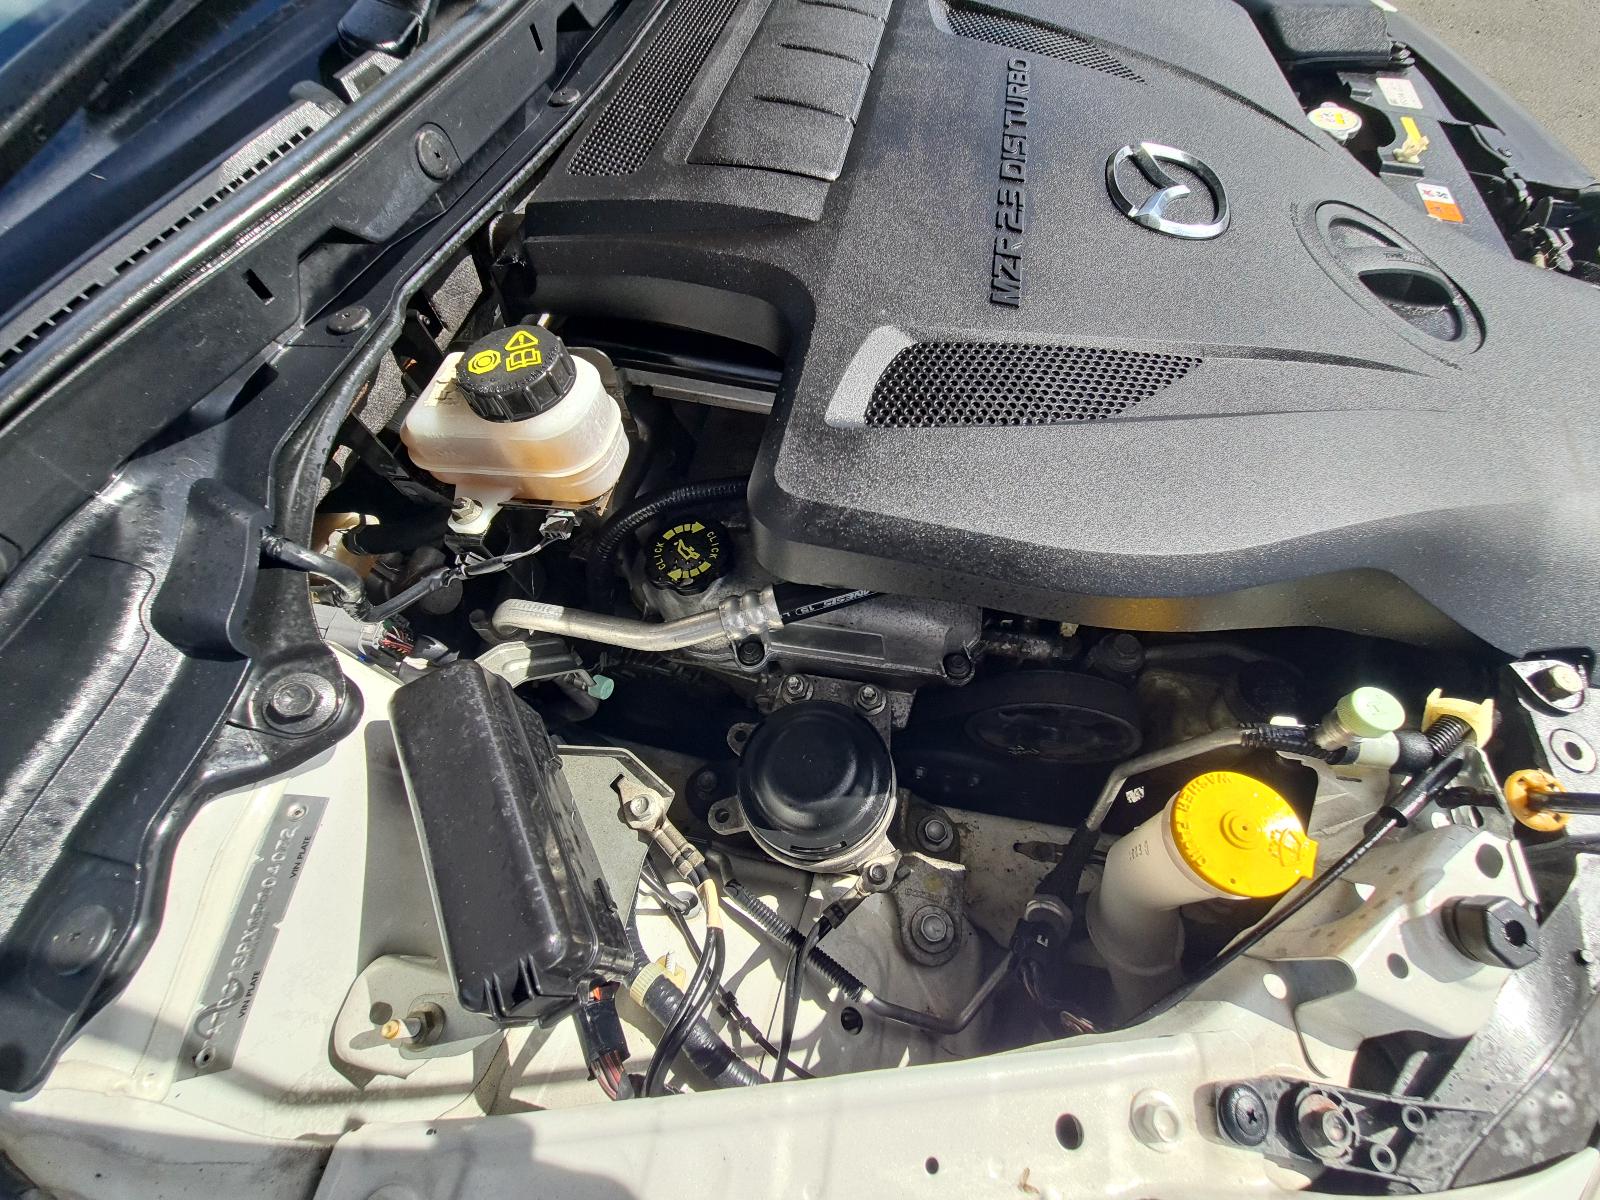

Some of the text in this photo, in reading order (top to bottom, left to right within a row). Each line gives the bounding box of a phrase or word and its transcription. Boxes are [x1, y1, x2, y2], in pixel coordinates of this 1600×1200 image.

[1003, 57, 1031, 128] TURBO
[990, 236, 1023, 309] MZR
[654, 542, 666, 570] CLICK
[706, 531, 719, 559] CLICK
[289, 835, 312, 879] VIN PLATE
[237, 970, 261, 1018] VIN PLATE
